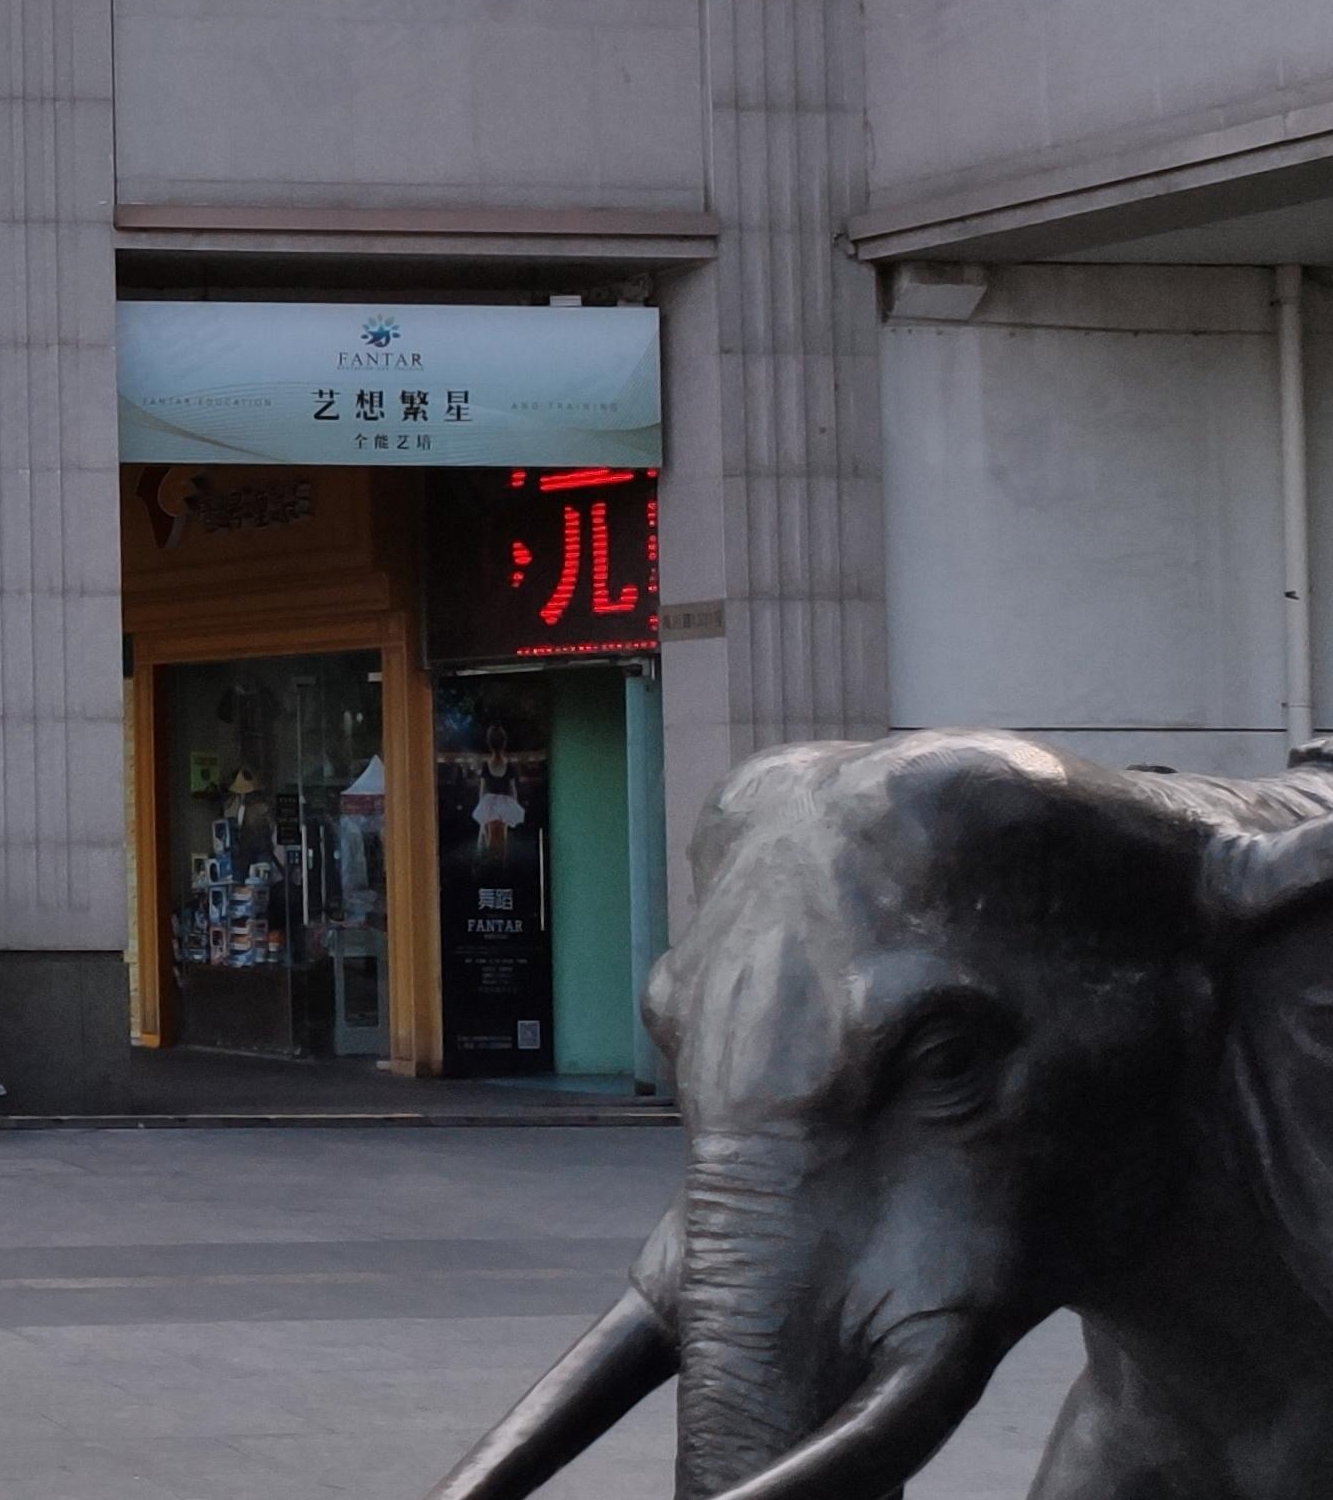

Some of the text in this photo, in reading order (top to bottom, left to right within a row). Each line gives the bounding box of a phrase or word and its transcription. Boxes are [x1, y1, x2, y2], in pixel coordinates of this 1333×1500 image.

[338, 352, 423, 367] FANTAR
[311, 387, 473, 423] 艺想繁星
[352, 433, 433, 451] 全能艺培
[467, 919, 523, 933] FANTAR
